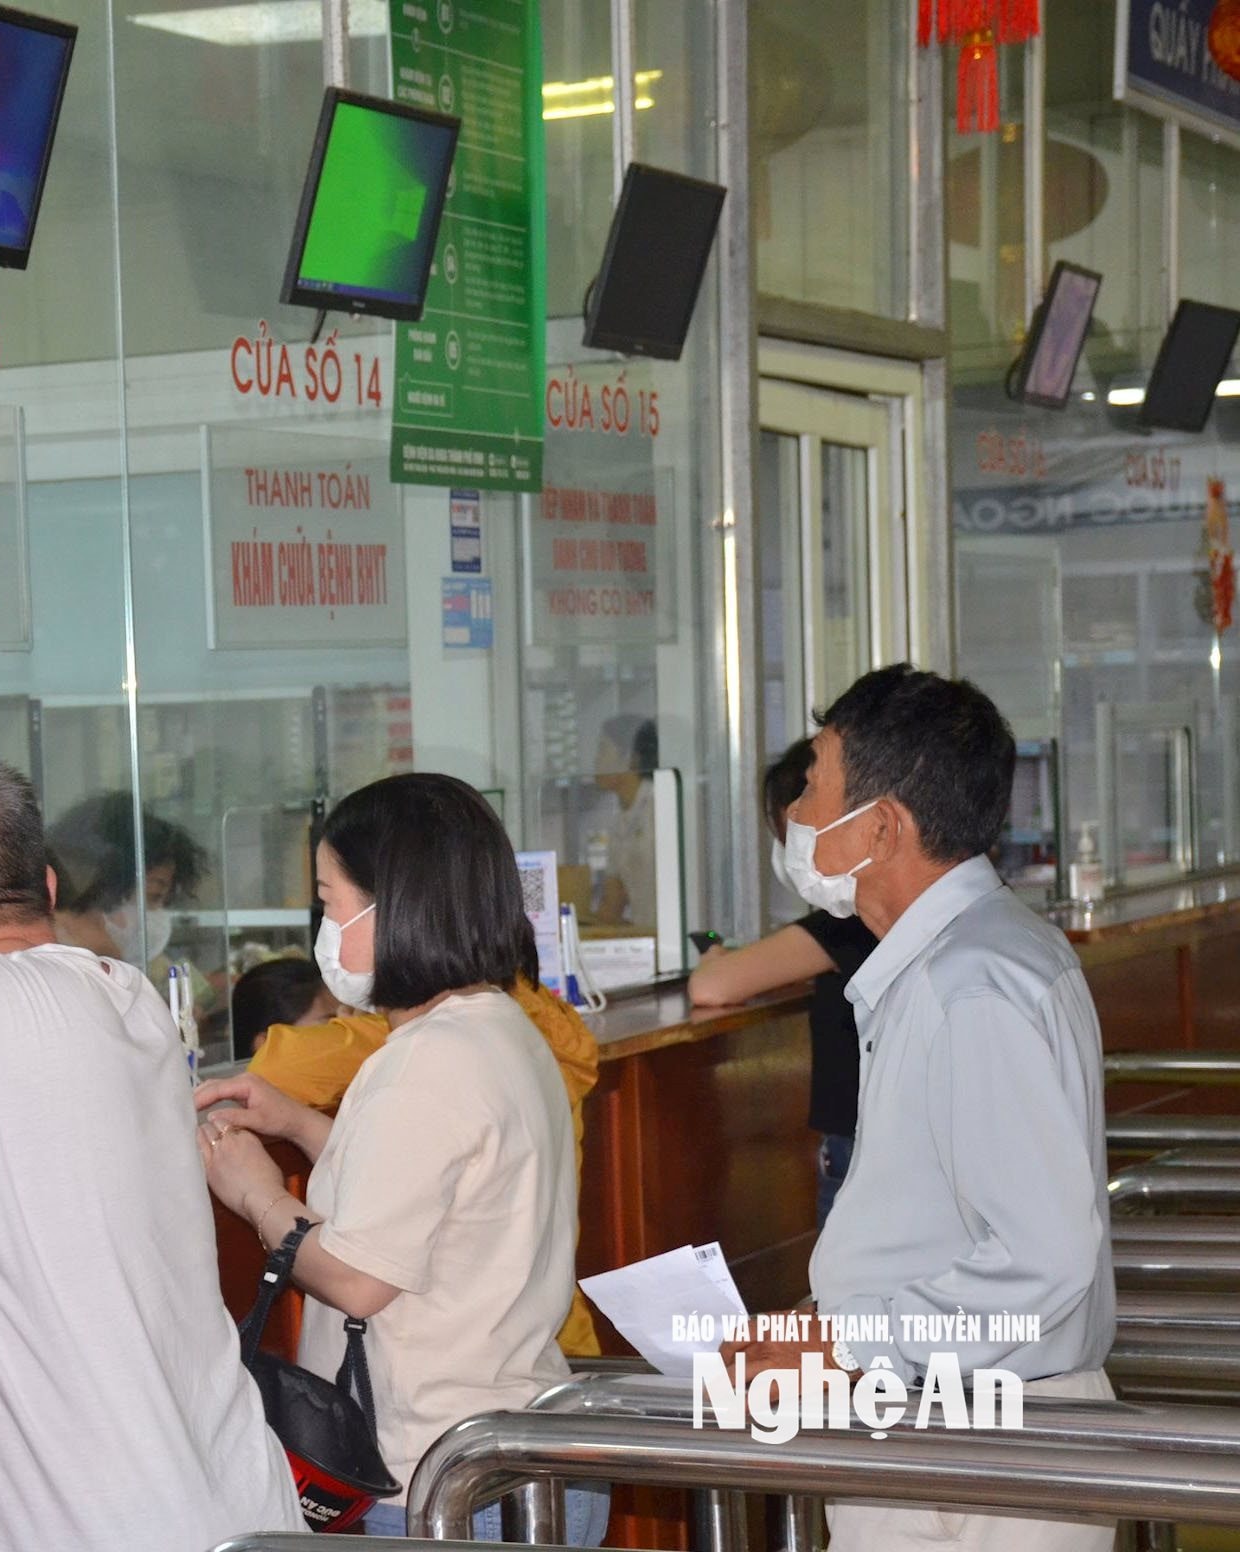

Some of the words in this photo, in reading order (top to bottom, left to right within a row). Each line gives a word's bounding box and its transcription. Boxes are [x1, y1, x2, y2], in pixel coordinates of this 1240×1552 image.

[231, 320, 297, 398] CỬA
[304, 328, 342, 403] SỐ
[354, 352, 382, 408] 14
[545, 364, 595, 430] CỬA
[600, 369, 631, 434] SỐ
[639, 389, 660, 437] 15
[244, 468, 313, 508] THANH
[317, 463, 371, 510] TOÁN
[231, 527, 275, 607] KHÁM
[278, 525, 316, 607] CHỮA
[317, 528, 354, 620] BỆNH
